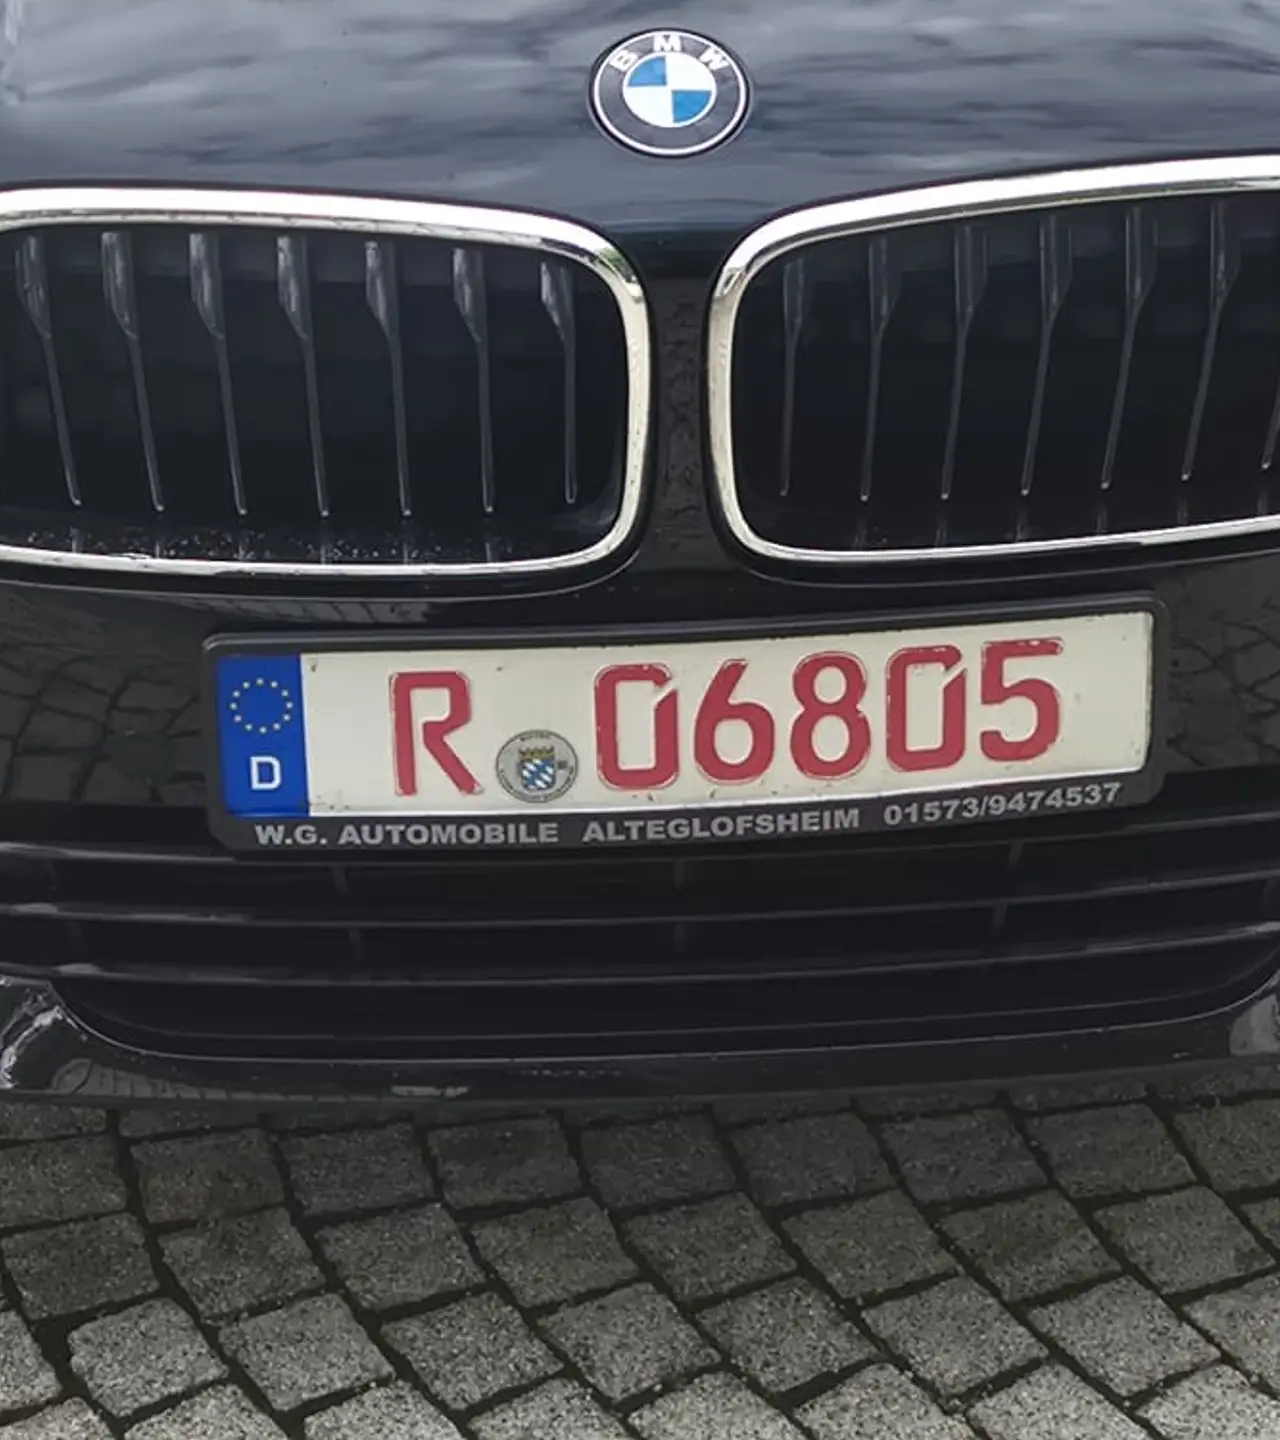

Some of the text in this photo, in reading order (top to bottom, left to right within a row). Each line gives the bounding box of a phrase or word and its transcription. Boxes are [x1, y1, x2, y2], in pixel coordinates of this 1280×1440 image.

[609, 34, 729, 72] BMW
[388, 670, 485, 796] R
[593, 637, 1064, 791] 06805
[249, 755, 282, 790] D
[255, 782, 1121, 846] W.G. AUTOMOBILE ALTEGLOFSHEIM 01573/9474537
